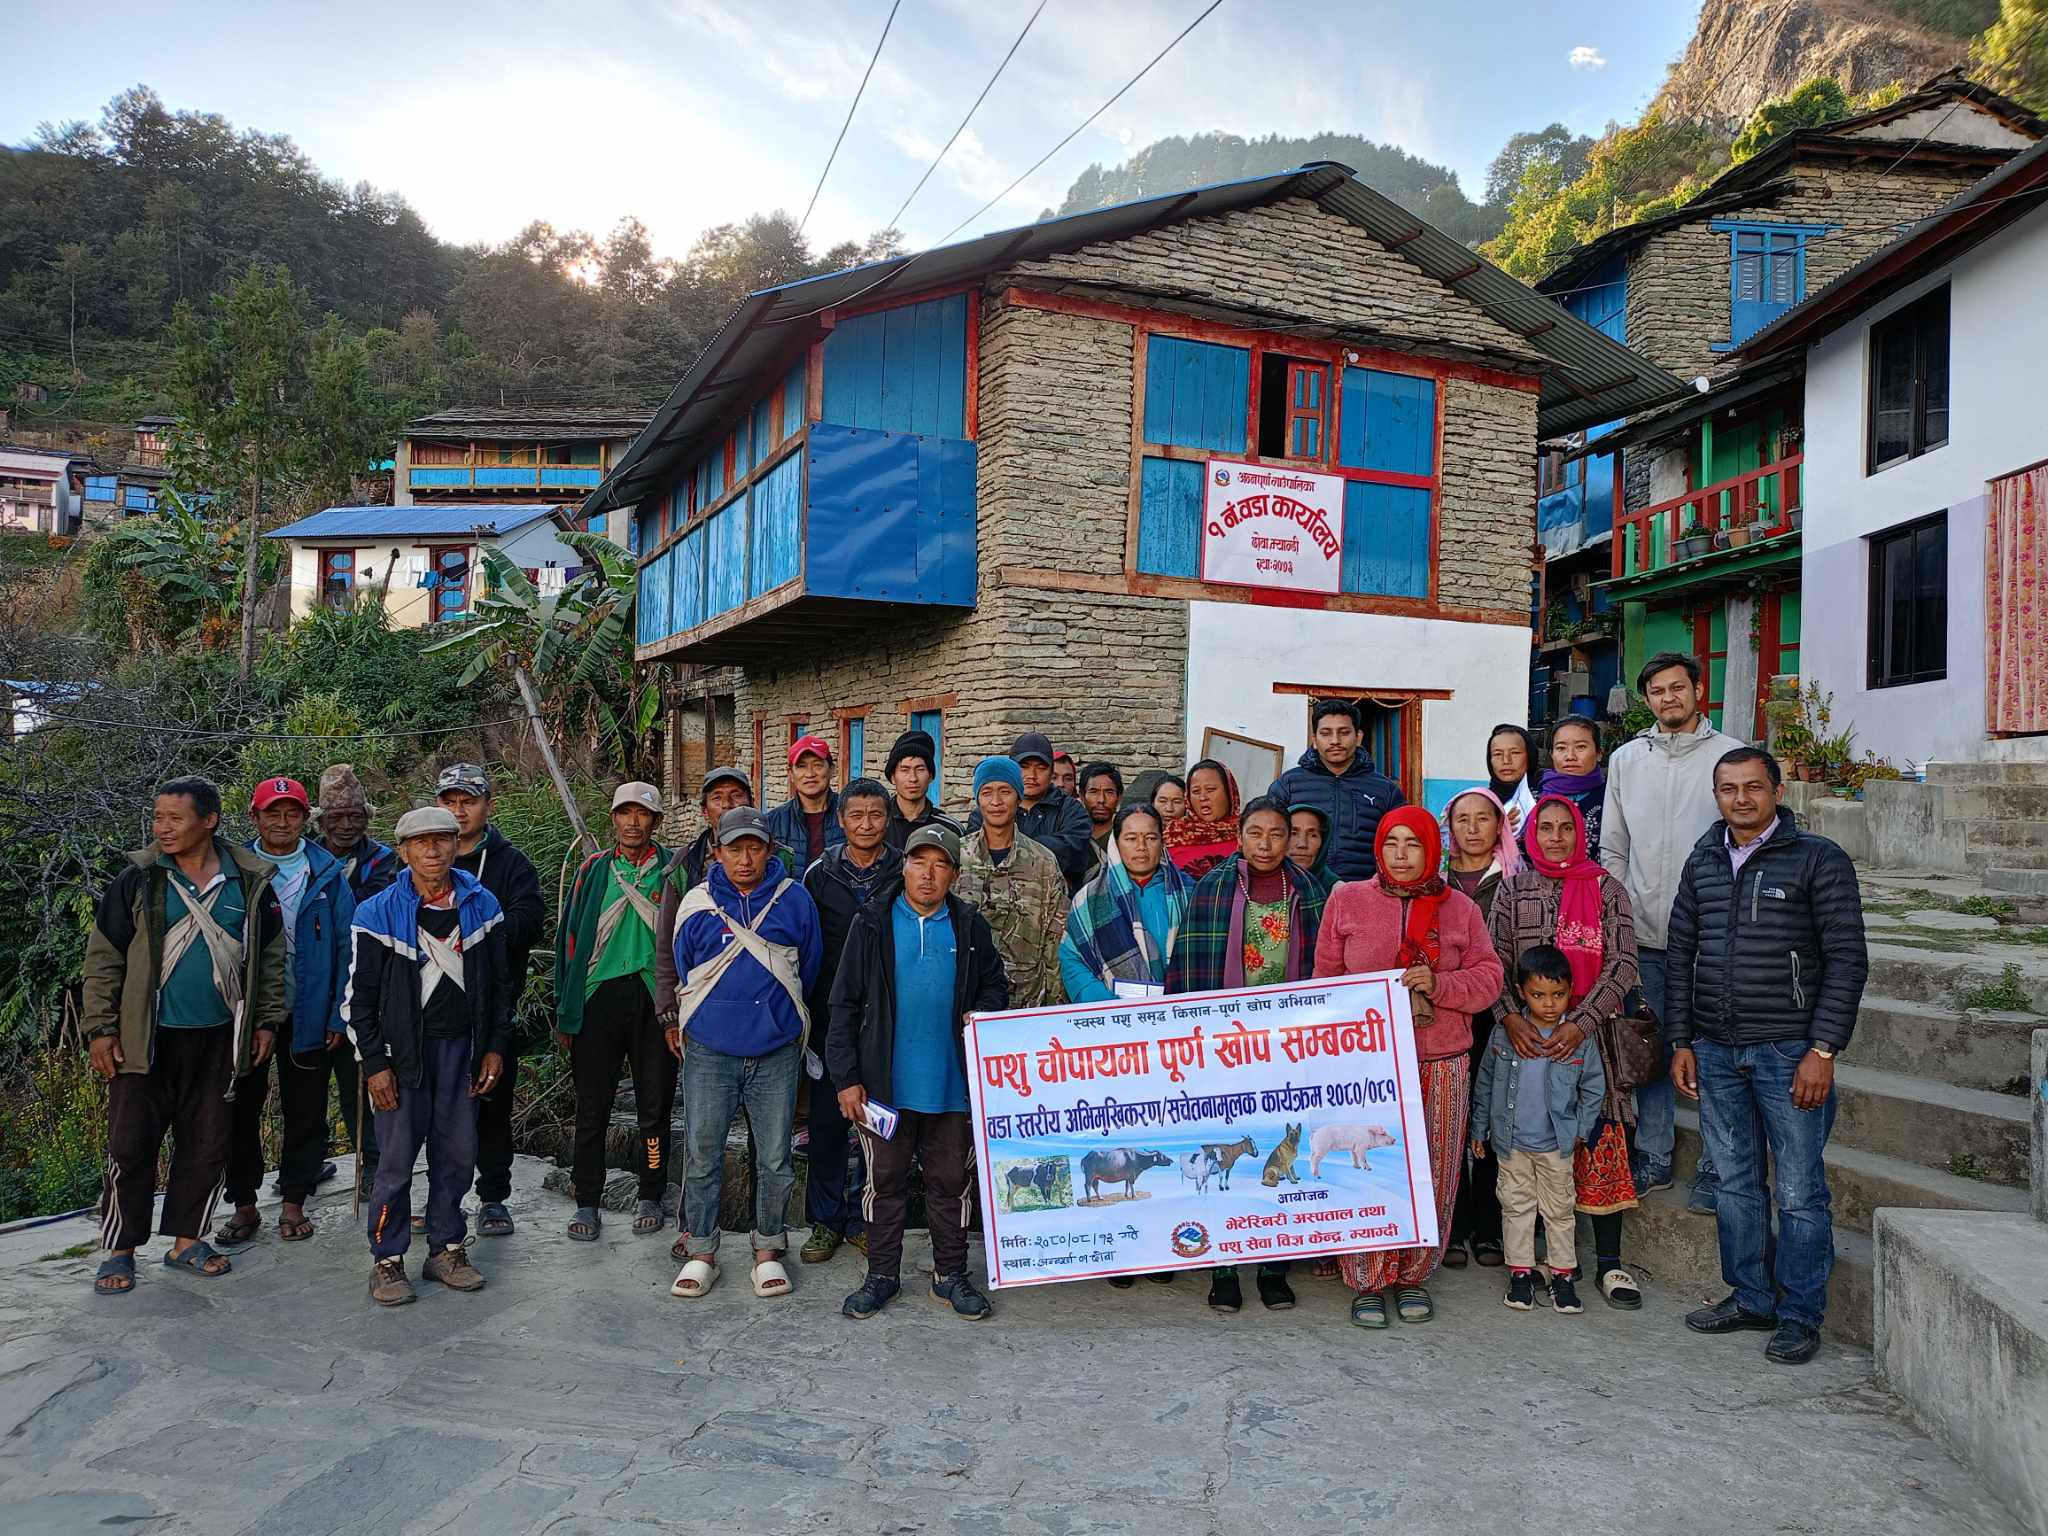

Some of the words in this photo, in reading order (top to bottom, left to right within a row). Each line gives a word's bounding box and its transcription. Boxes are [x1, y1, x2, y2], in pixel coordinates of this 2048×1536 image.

[1208, 521, 1226, 538] १
[1271, 494, 1340, 561] कार्यालय
[1111, 1014, 1131, 1028] पशु
[1137, 1011, 1166, 1026] समृद्ध
[1247, 998, 1272, 1012] खोप
[983, 1052, 1032, 1097] पशु
[1036, 1036, 1149, 1084] चौपायमा
[1157, 1025, 1205, 1083] पूर्ण
[1213, 1020, 1271, 1069] खोप
[1279, 1007, 1386, 1063] सम्बन्धी
[987, 1115, 1012, 1140] वडा
[1015, 1103, 1060, 1140] स्तरीय
[1261, 1081, 1323, 1115] कार्यक्रम
[1327, 1077, 1397, 1109] २०८०/०८१
[647, 1136, 661, 1169] NIKE
[1277, 1190, 1329, 1204] आयोजक
[1293, 1208, 1353, 1224] अस्पताल
[1358, 1205, 1386, 1218] तथा
[1219, 1241, 1241, 1254] पशु
[1246, 1237, 1272, 1250] सेवा
[1350, 1223, 1399, 1240] म्याग्दी
